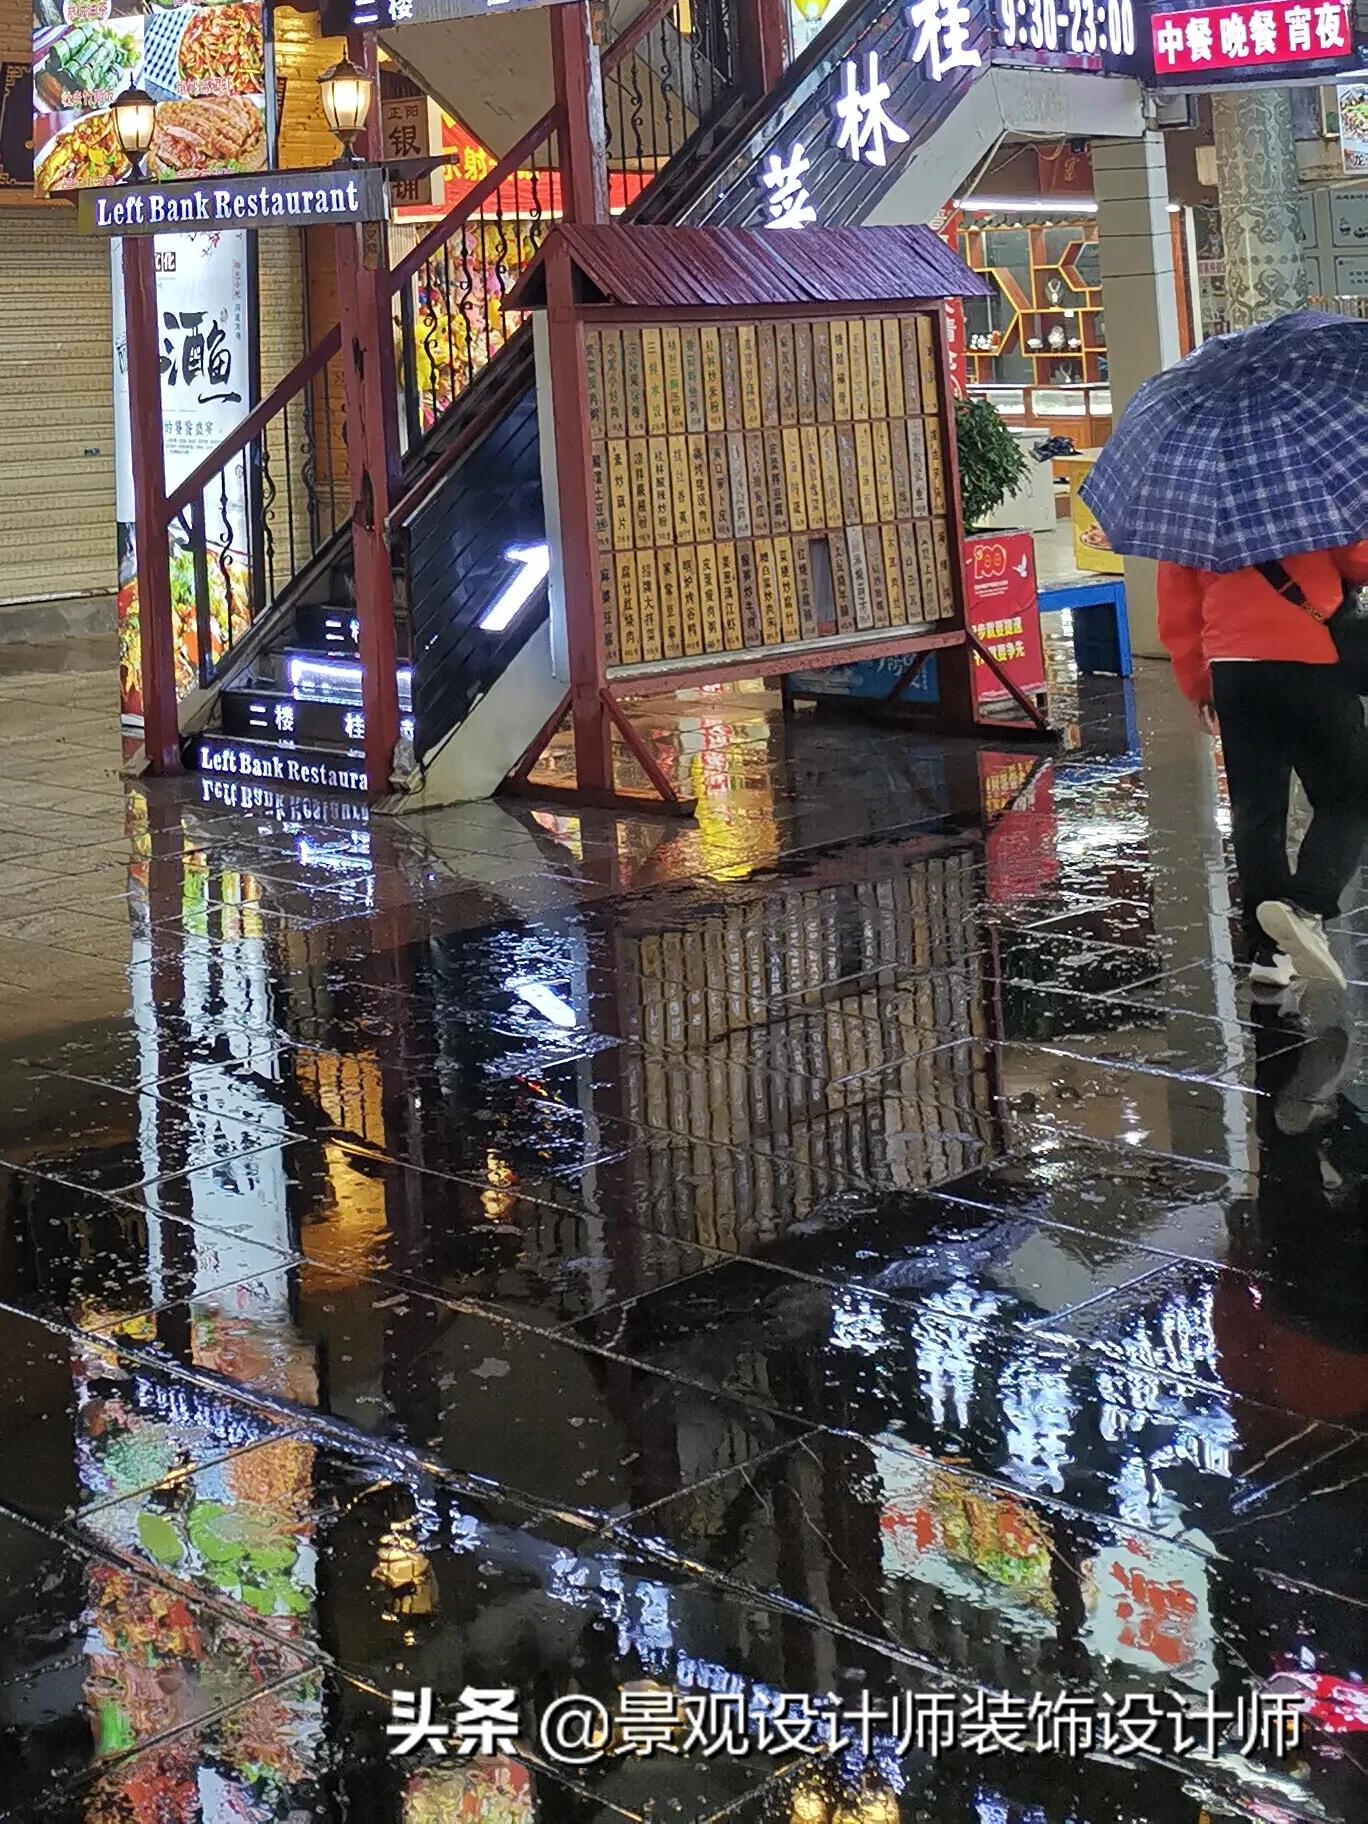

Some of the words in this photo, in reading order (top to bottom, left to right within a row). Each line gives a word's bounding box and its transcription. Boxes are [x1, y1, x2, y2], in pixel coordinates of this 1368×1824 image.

[1158, 16, 1213, 66] 中餐
[1220, 7, 1278, 61] 晚餐
[1283, 1, 1345, 54] 宵夜
[387, 104, 419, 121] 正阳
[96, 191, 145, 227] Left
[149, 190, 210, 223] Bank
[213, 179, 359, 220] Restaurant
[972, 616, 1023, 640] 步就要提速
[249, 704, 294, 732] 二楼
[200, 747, 236, 773] Left
[239, 751, 284, 778] Bank
[287, 760, 369, 791] Restaura
